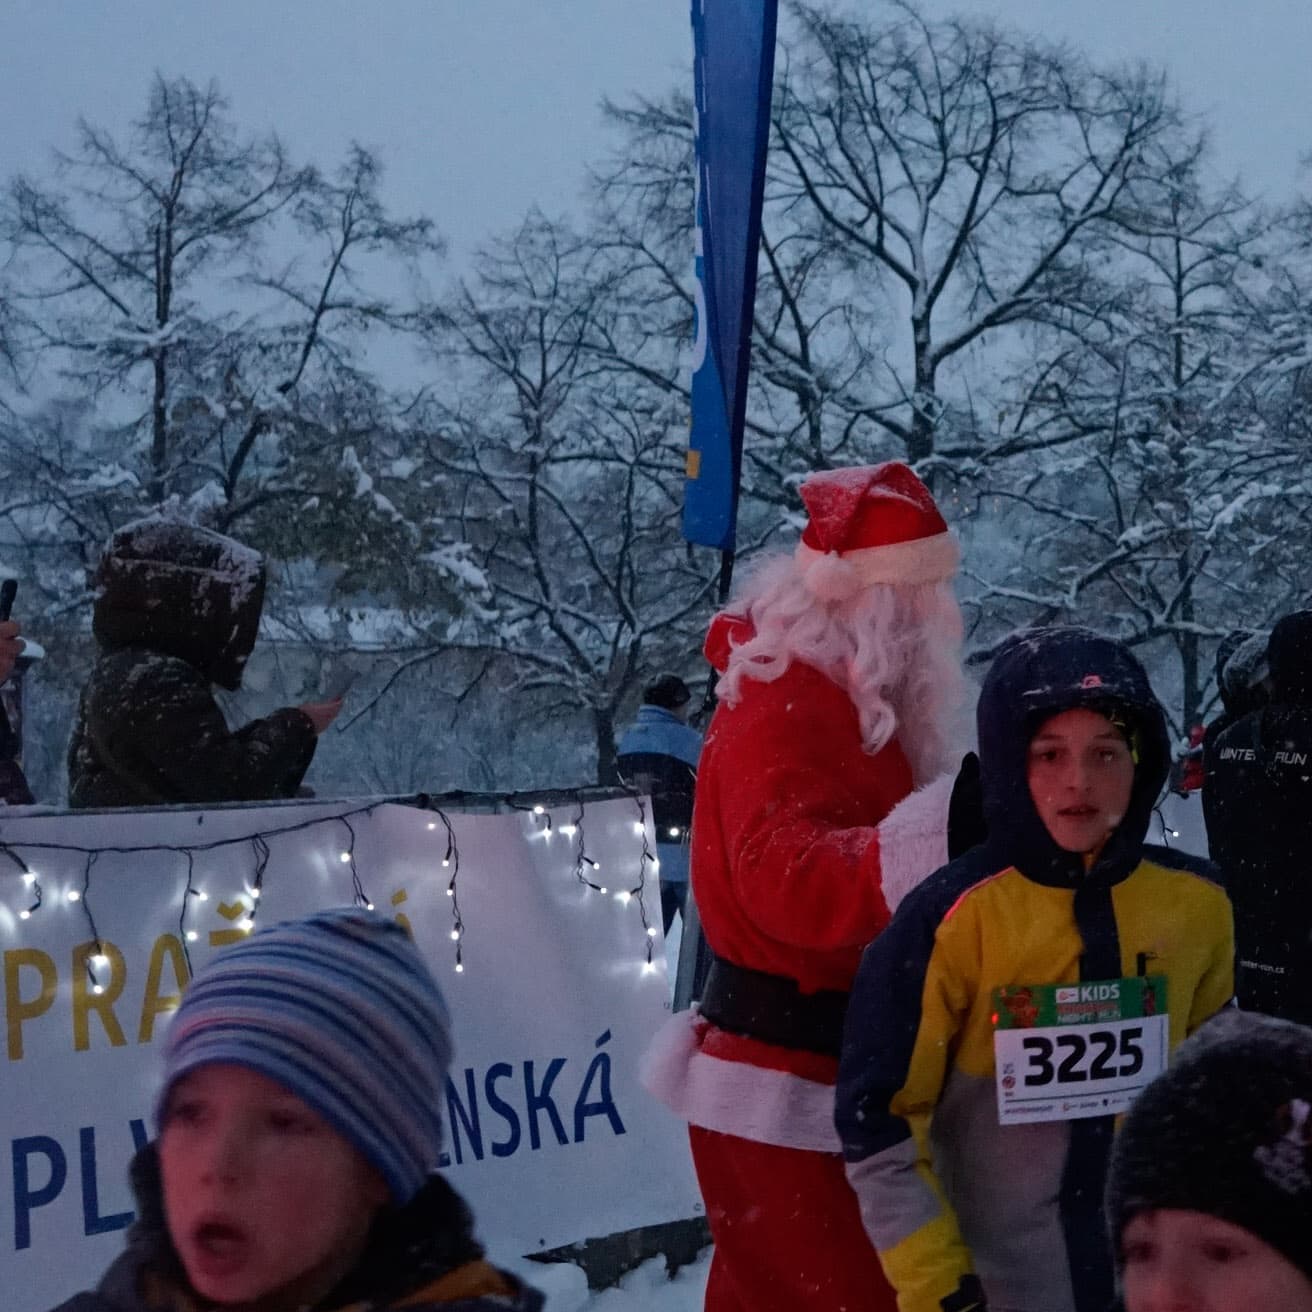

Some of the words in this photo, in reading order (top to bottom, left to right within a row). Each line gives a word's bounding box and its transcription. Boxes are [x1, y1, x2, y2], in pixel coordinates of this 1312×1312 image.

[1219, 747, 1256, 761] WINTE
[1081, 983, 1120, 1002] KIDS
[1023, 1028, 1143, 1086] 3225
